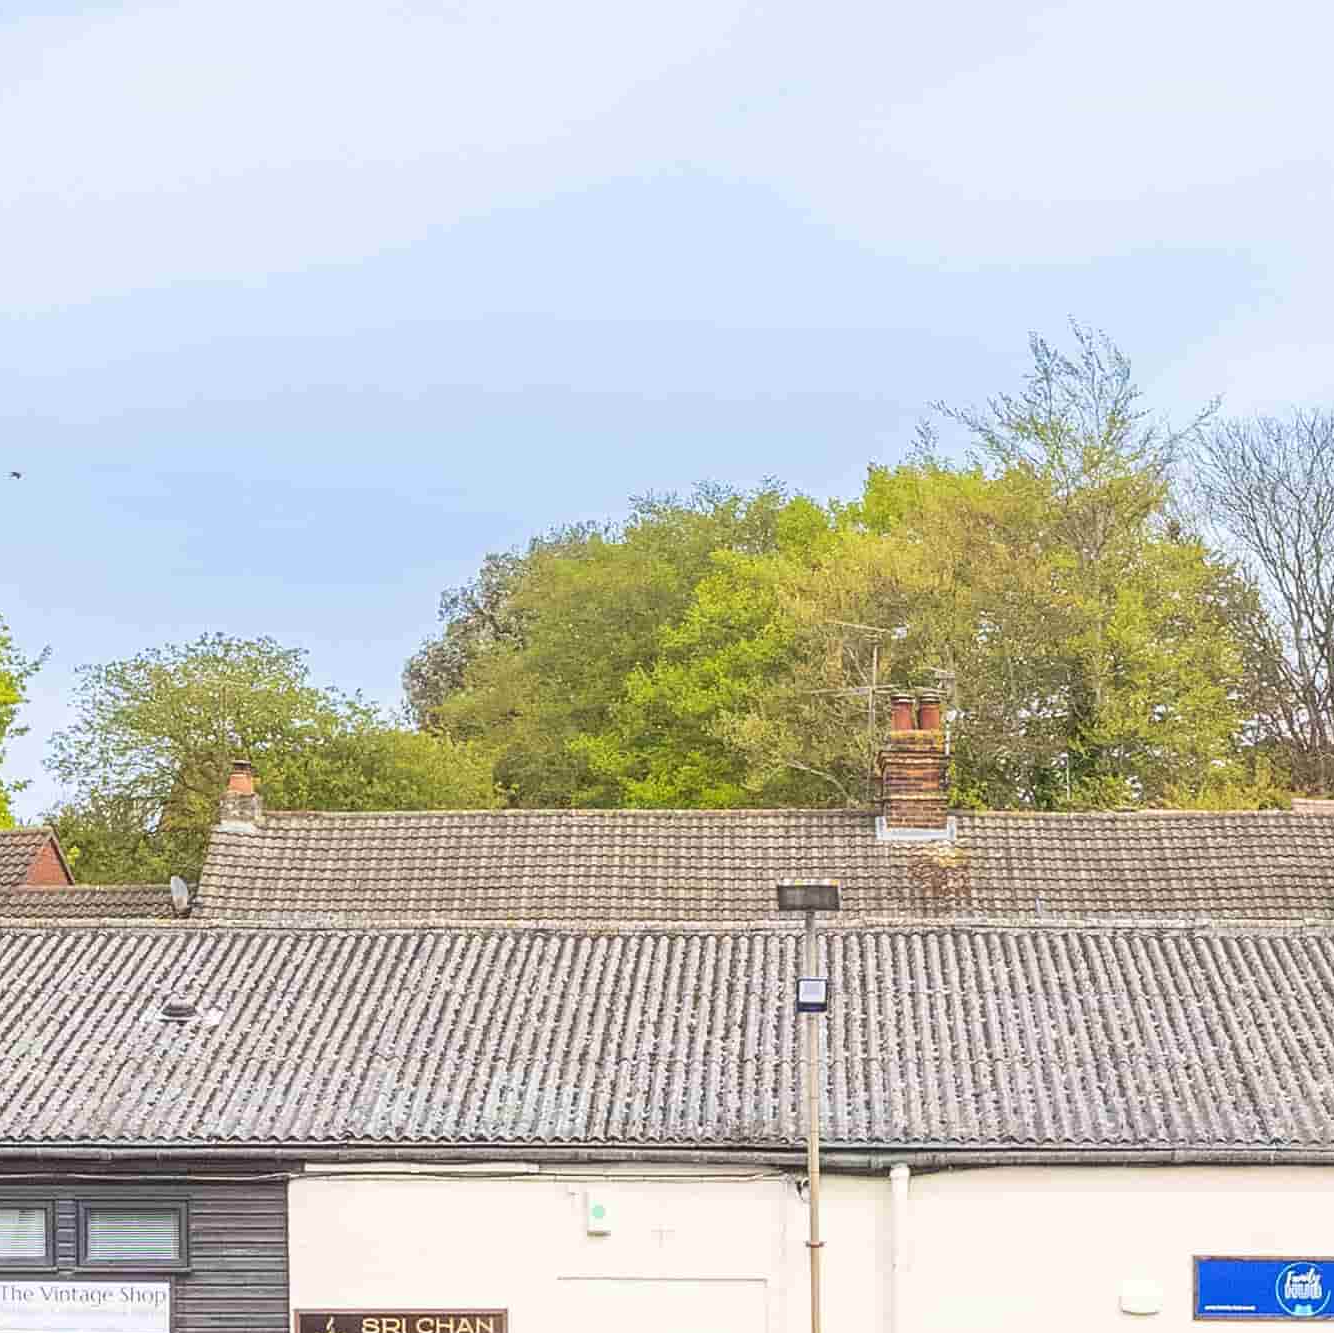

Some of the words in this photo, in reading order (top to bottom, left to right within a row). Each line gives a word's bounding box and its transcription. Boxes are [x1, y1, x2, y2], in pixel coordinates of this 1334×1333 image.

[2, 1285, 34, 1301] The
[40, 1285, 114, 1308] Vintage
[120, 1285, 167, 1306] Shop
